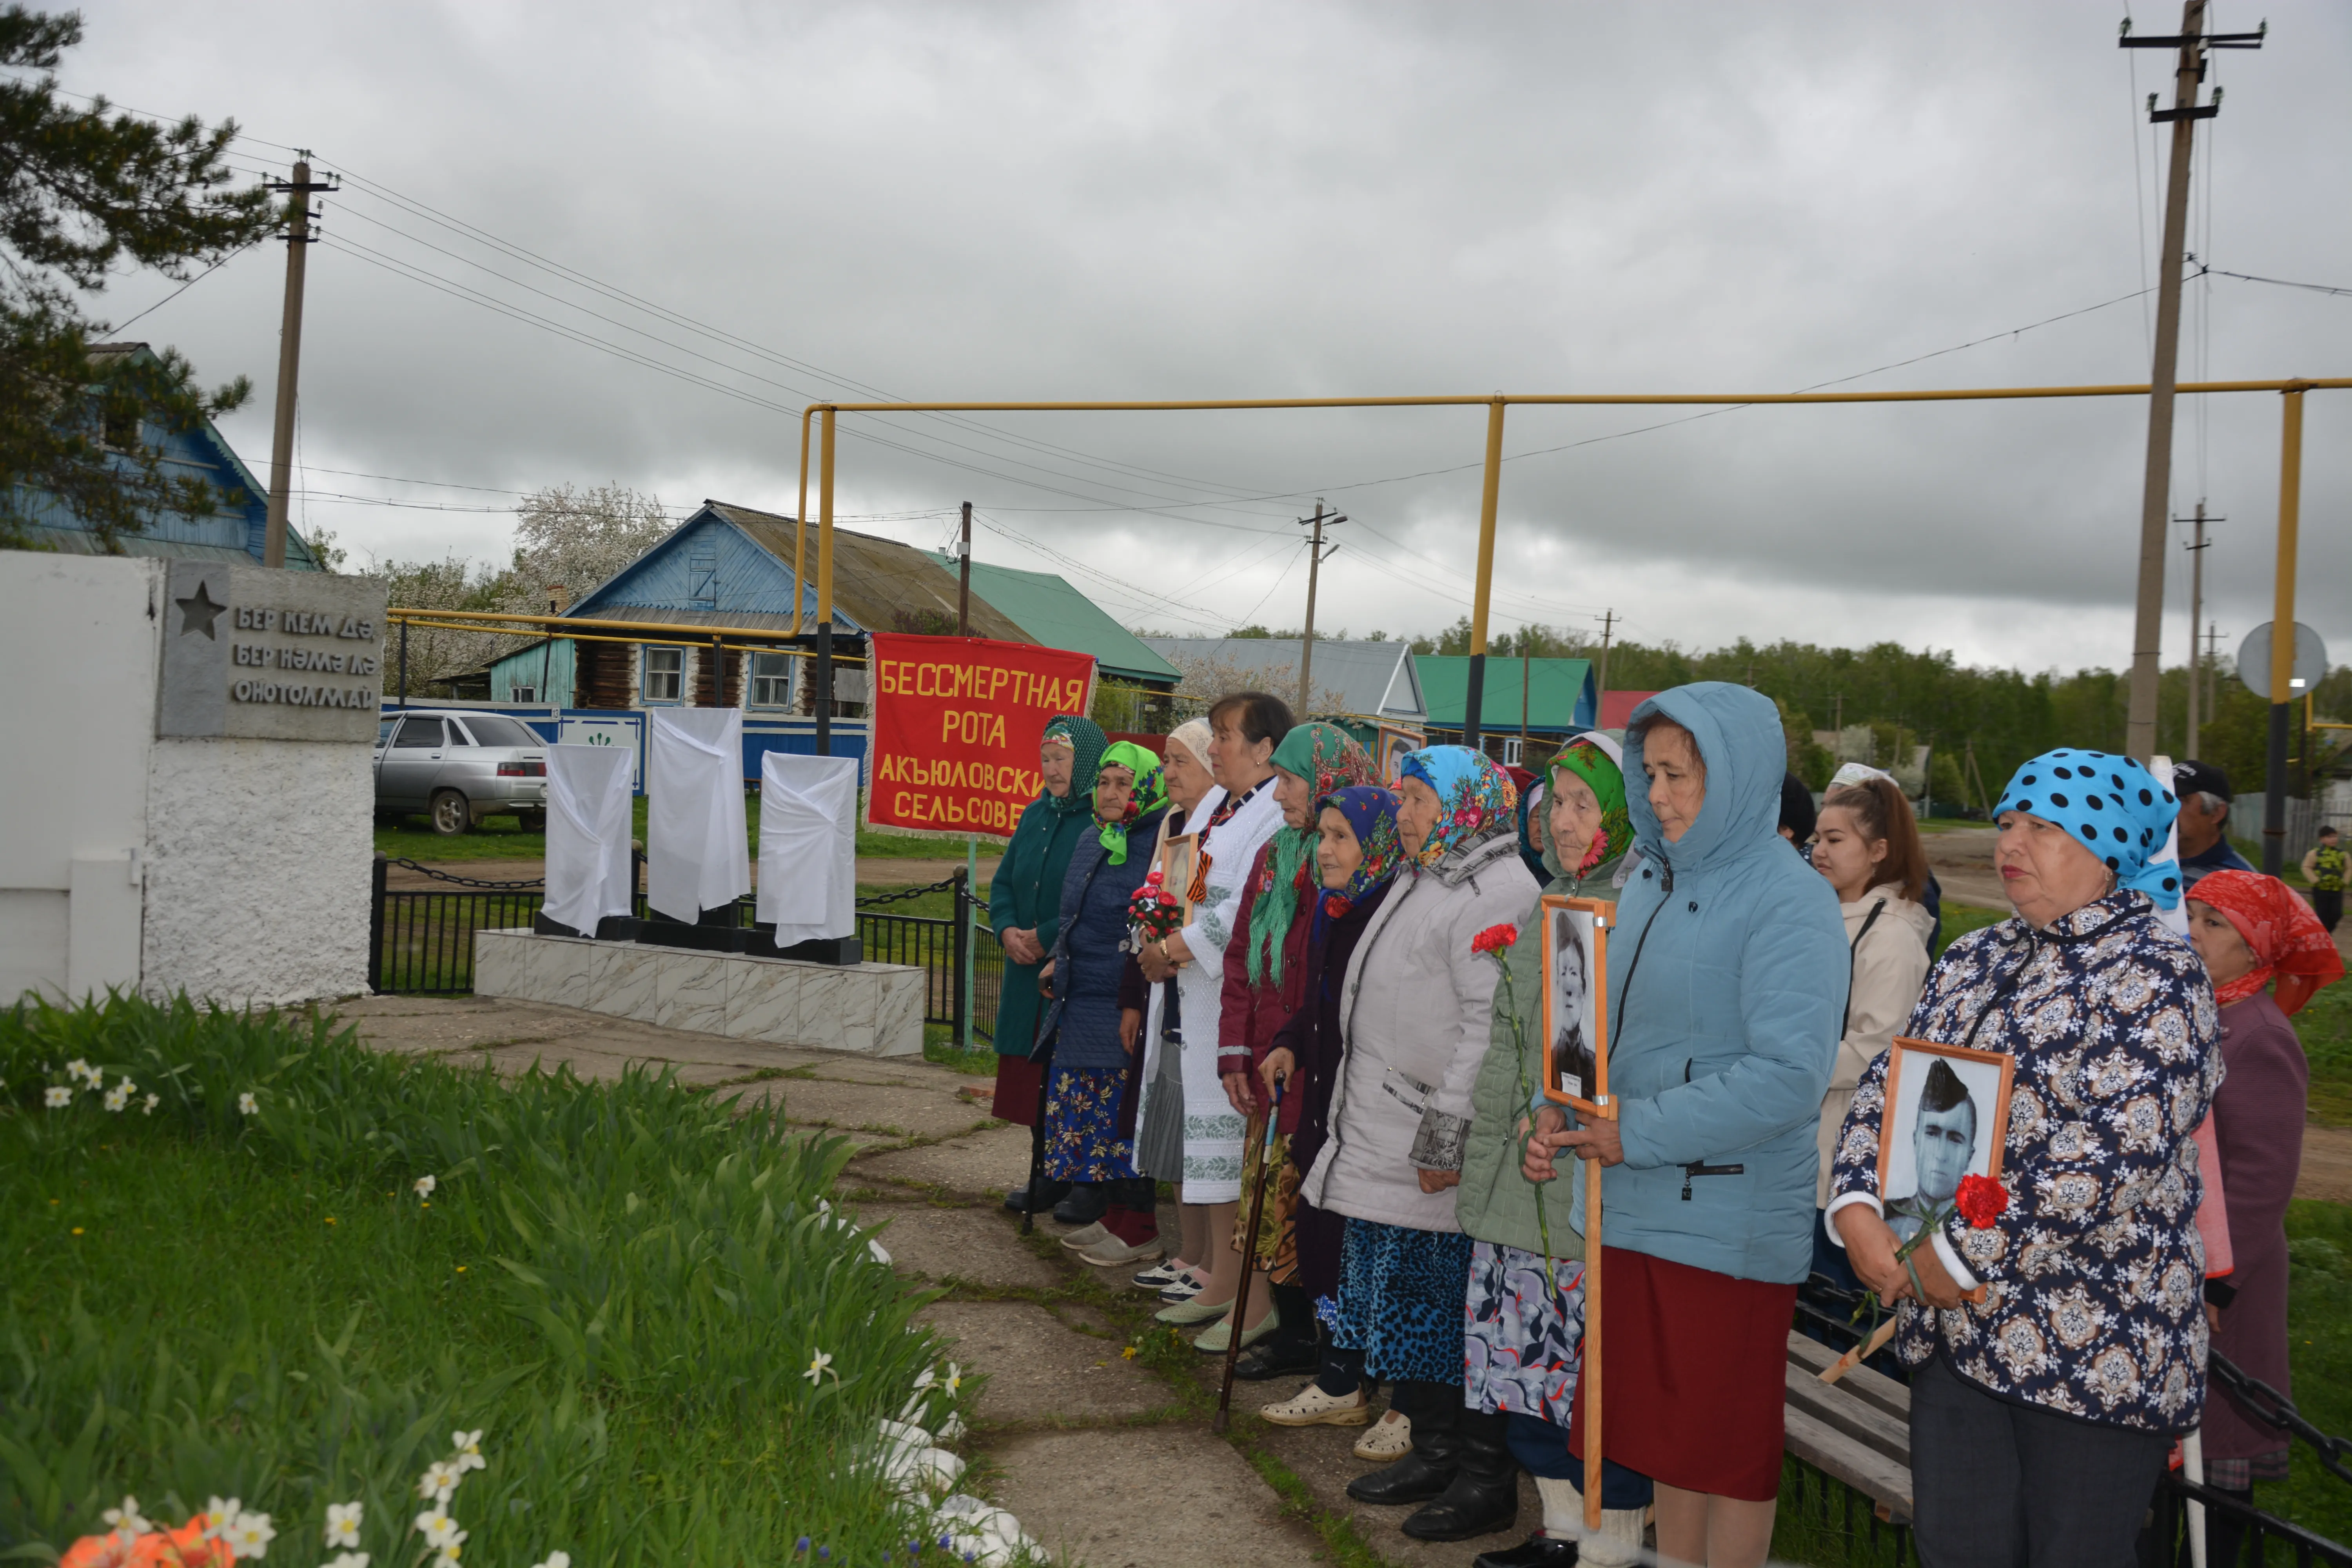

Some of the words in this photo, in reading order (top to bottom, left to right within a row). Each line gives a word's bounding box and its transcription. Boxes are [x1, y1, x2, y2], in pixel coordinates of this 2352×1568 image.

[238, 607, 277, 630] БЕР
[285, 611, 334, 635] КЕМ
[236, 643, 275, 666] БЕР
[236, 680, 376, 709] ОНОТОЛМАЙ
[880, 660, 1083, 712] БЕССМЕРТНАЯ
[553, 709, 559, 719] 13
[942, 710, 1006, 748] РОТА
[894, 791, 1026, 830] СЕЛЬСОВЕ
